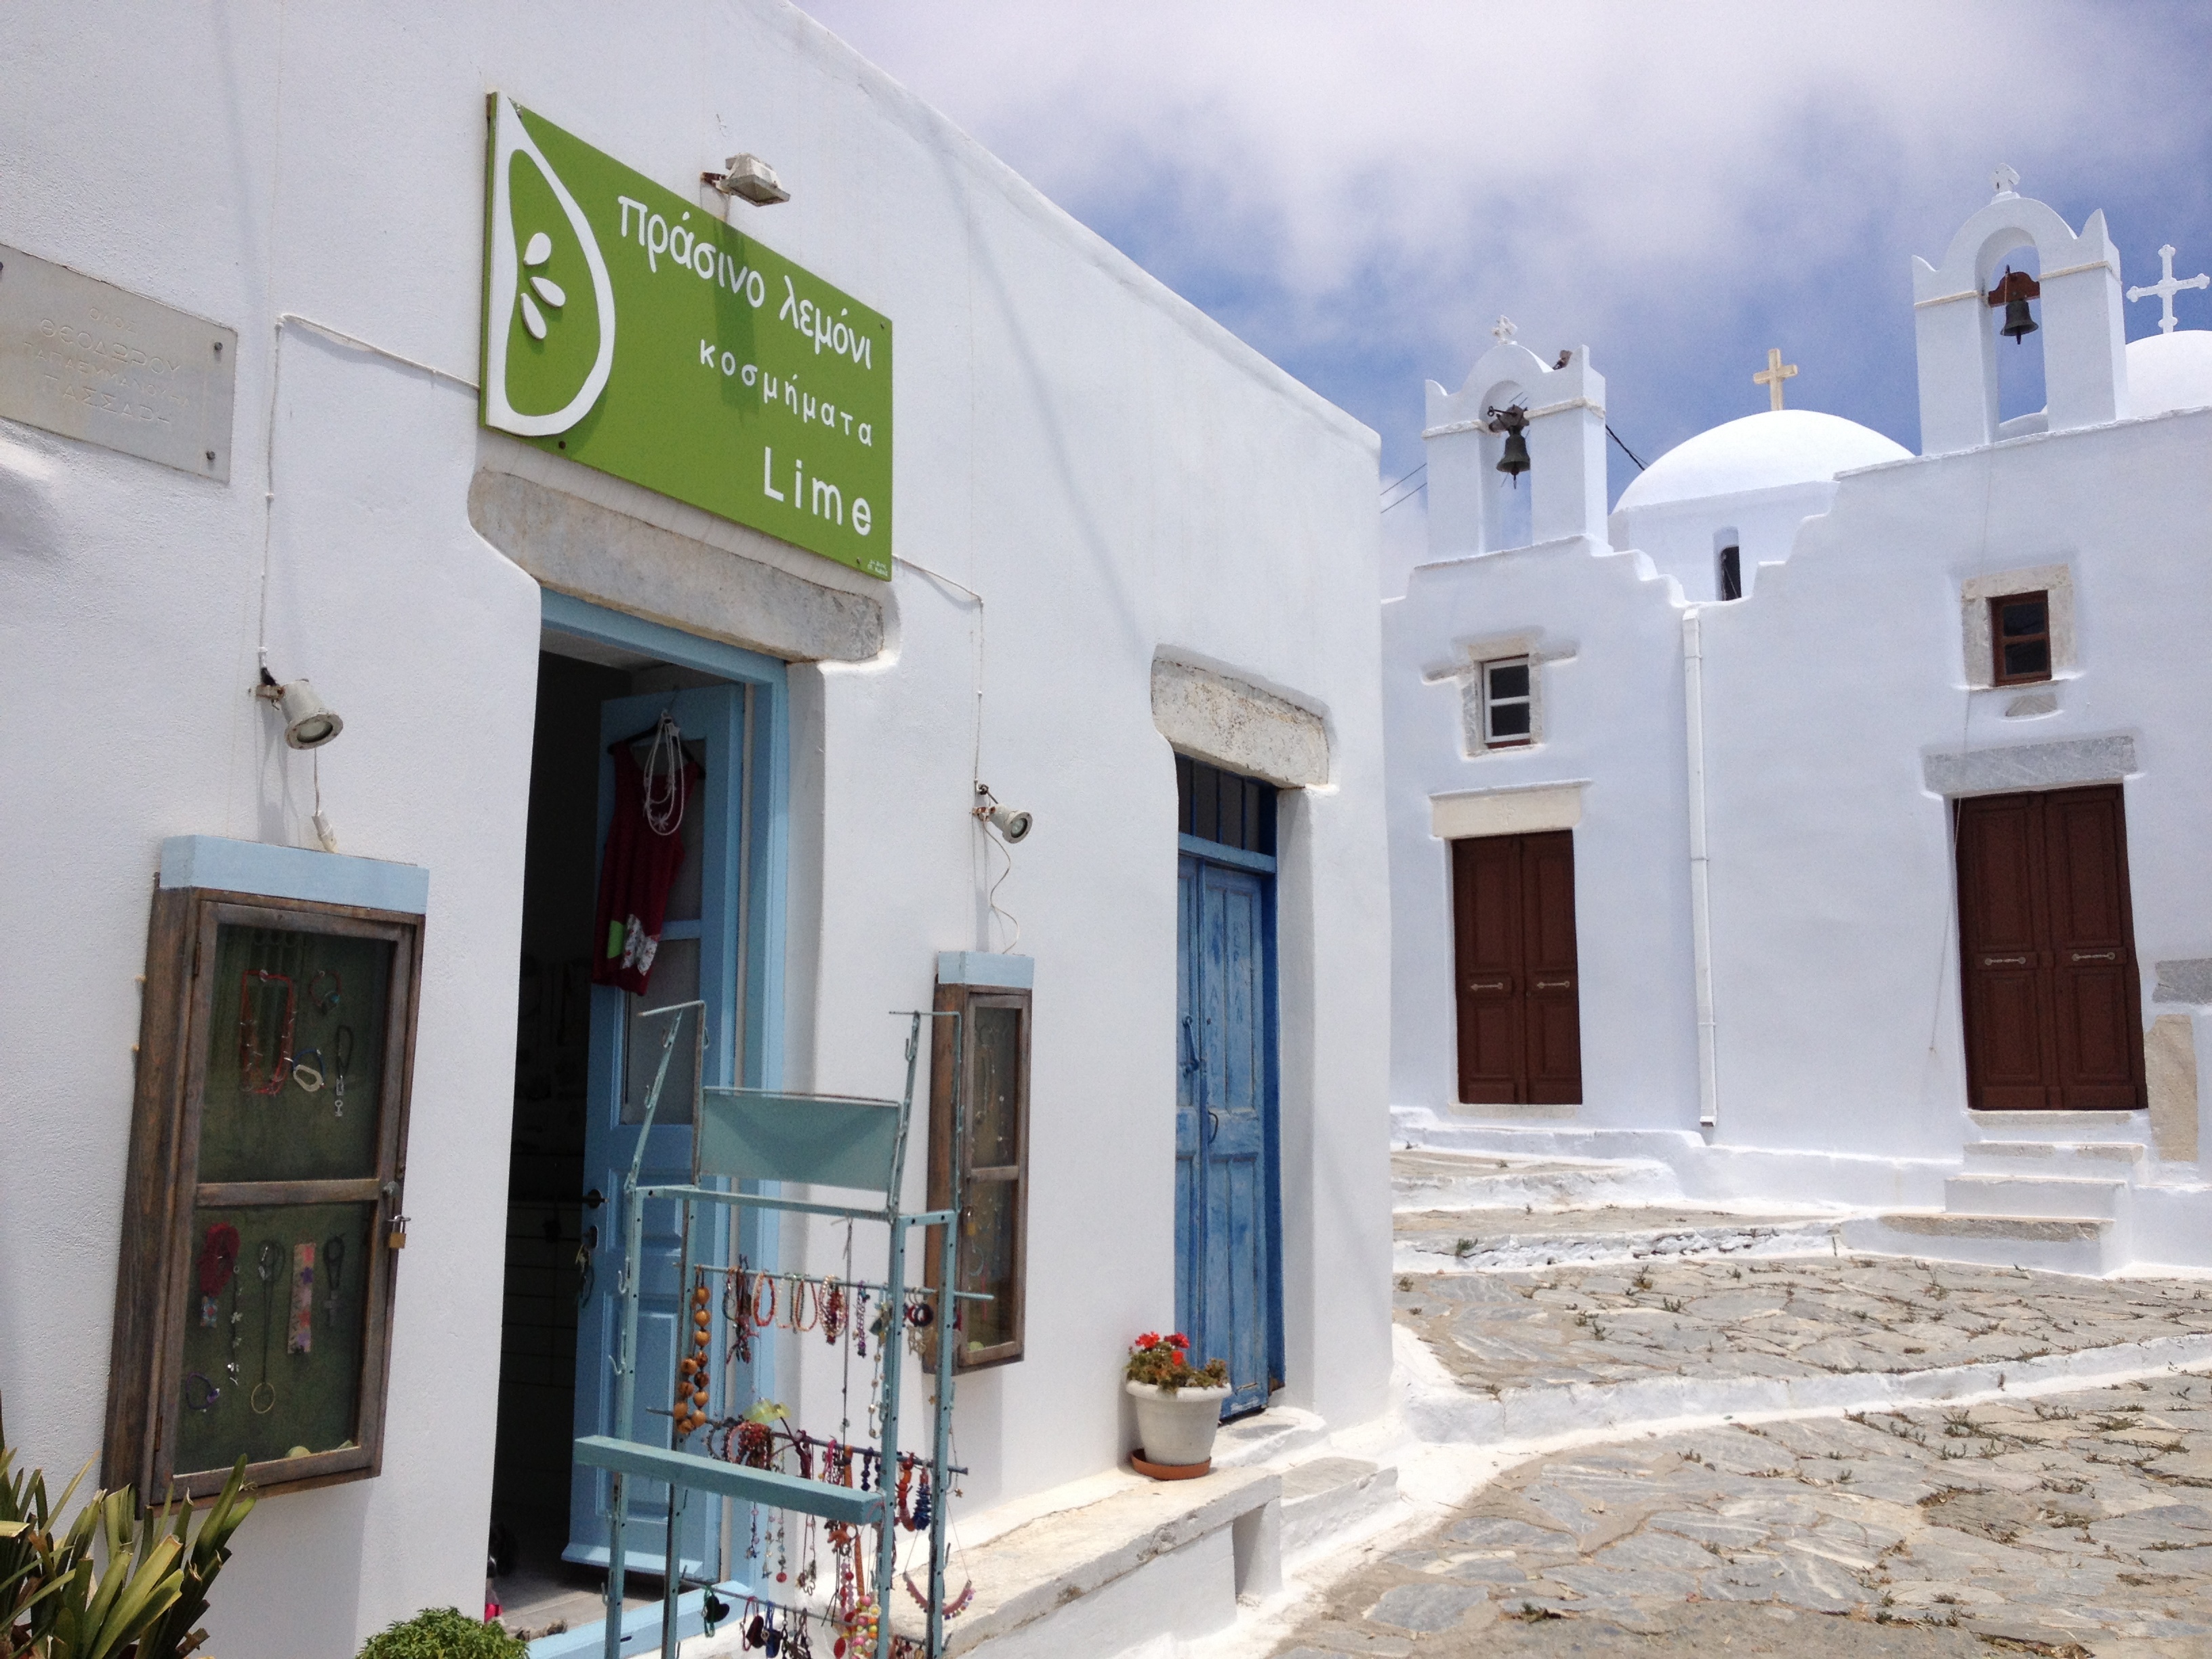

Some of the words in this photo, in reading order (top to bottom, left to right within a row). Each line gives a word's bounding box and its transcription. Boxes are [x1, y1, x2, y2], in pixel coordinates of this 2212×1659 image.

[39, 317, 181, 380] ΘΕΟΔΩΡΟΥ
[89, 306, 137, 334] ΟΔΟΣ
[779, 274, 872, 370] λεμόνι
[699, 339, 872, 447] κοσμήματα
[764, 446, 872, 536] Lime
